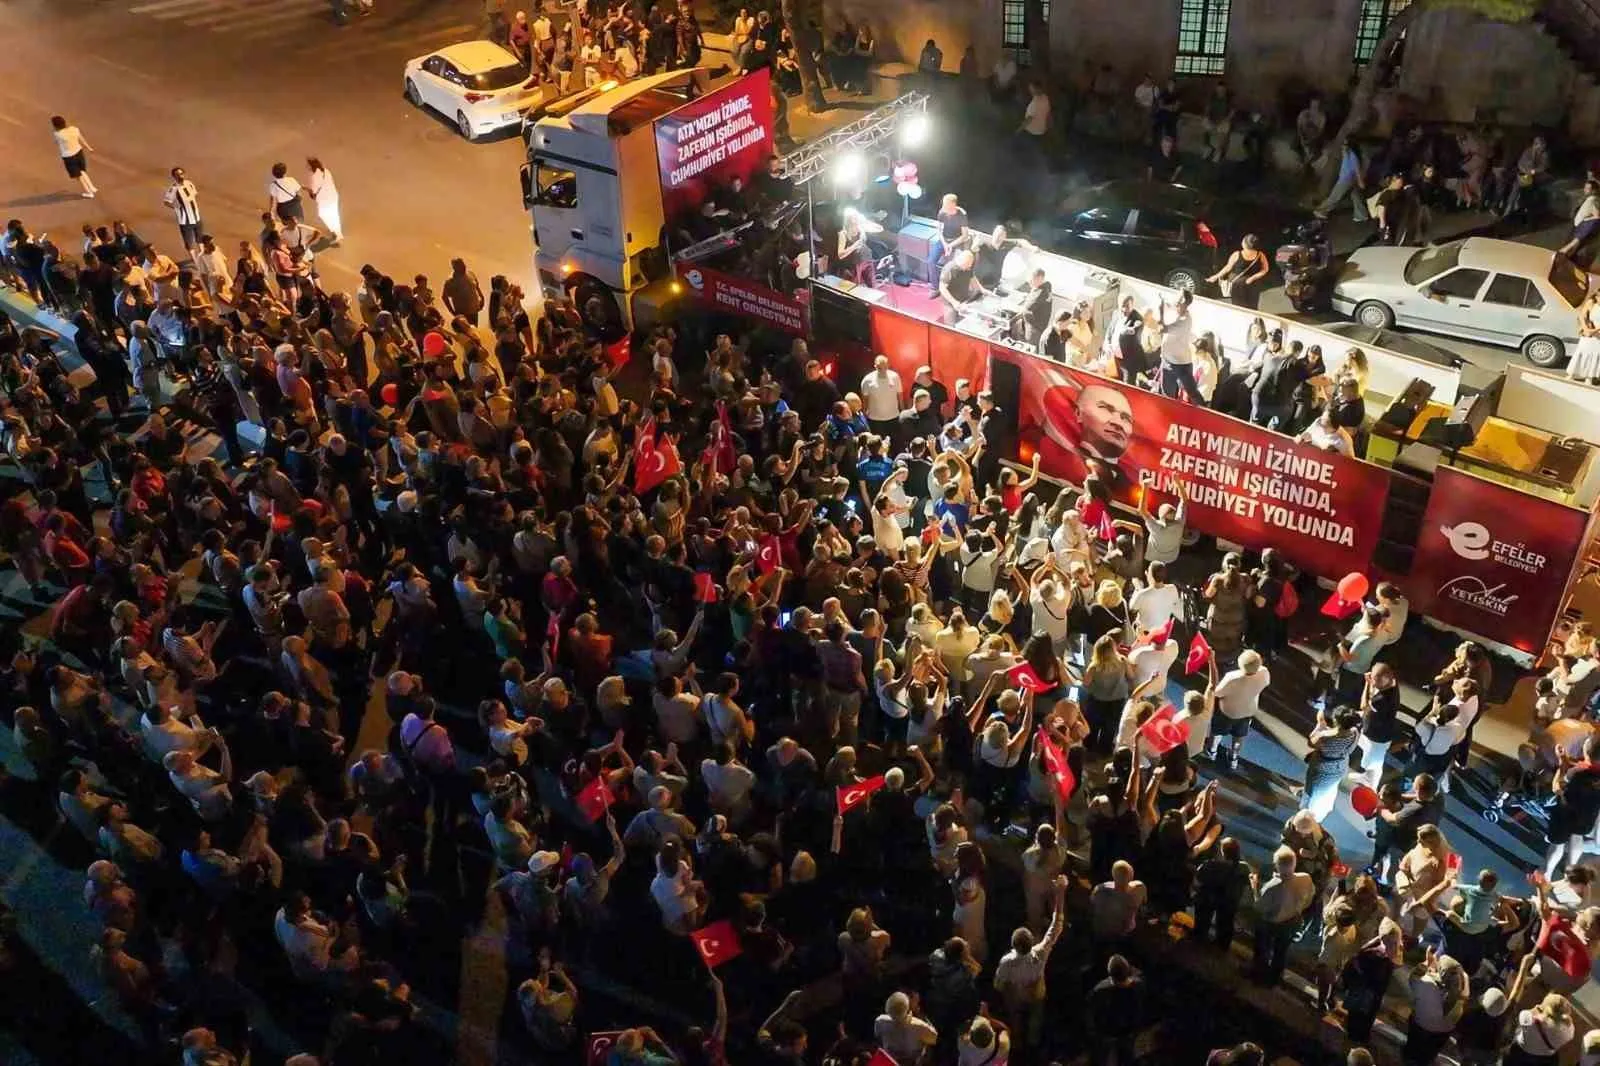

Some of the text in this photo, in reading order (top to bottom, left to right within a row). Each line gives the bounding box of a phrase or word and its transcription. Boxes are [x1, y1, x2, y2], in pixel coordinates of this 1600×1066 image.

[678, 109, 721, 143] ATA'MIZIN
[678, 129, 715, 162] ZAFERİN
[670, 126, 765, 185] CUMHURİYET YOLUNDA
[1166, 423, 1339, 489] ATA'MIZIN İZİNDE,
[1159, 448, 1336, 517] ZAFERİN IŞIĞINDA,
[1261, 503, 1354, 547] YOLUNDA
[1491, 540, 1546, 568] EFELER
